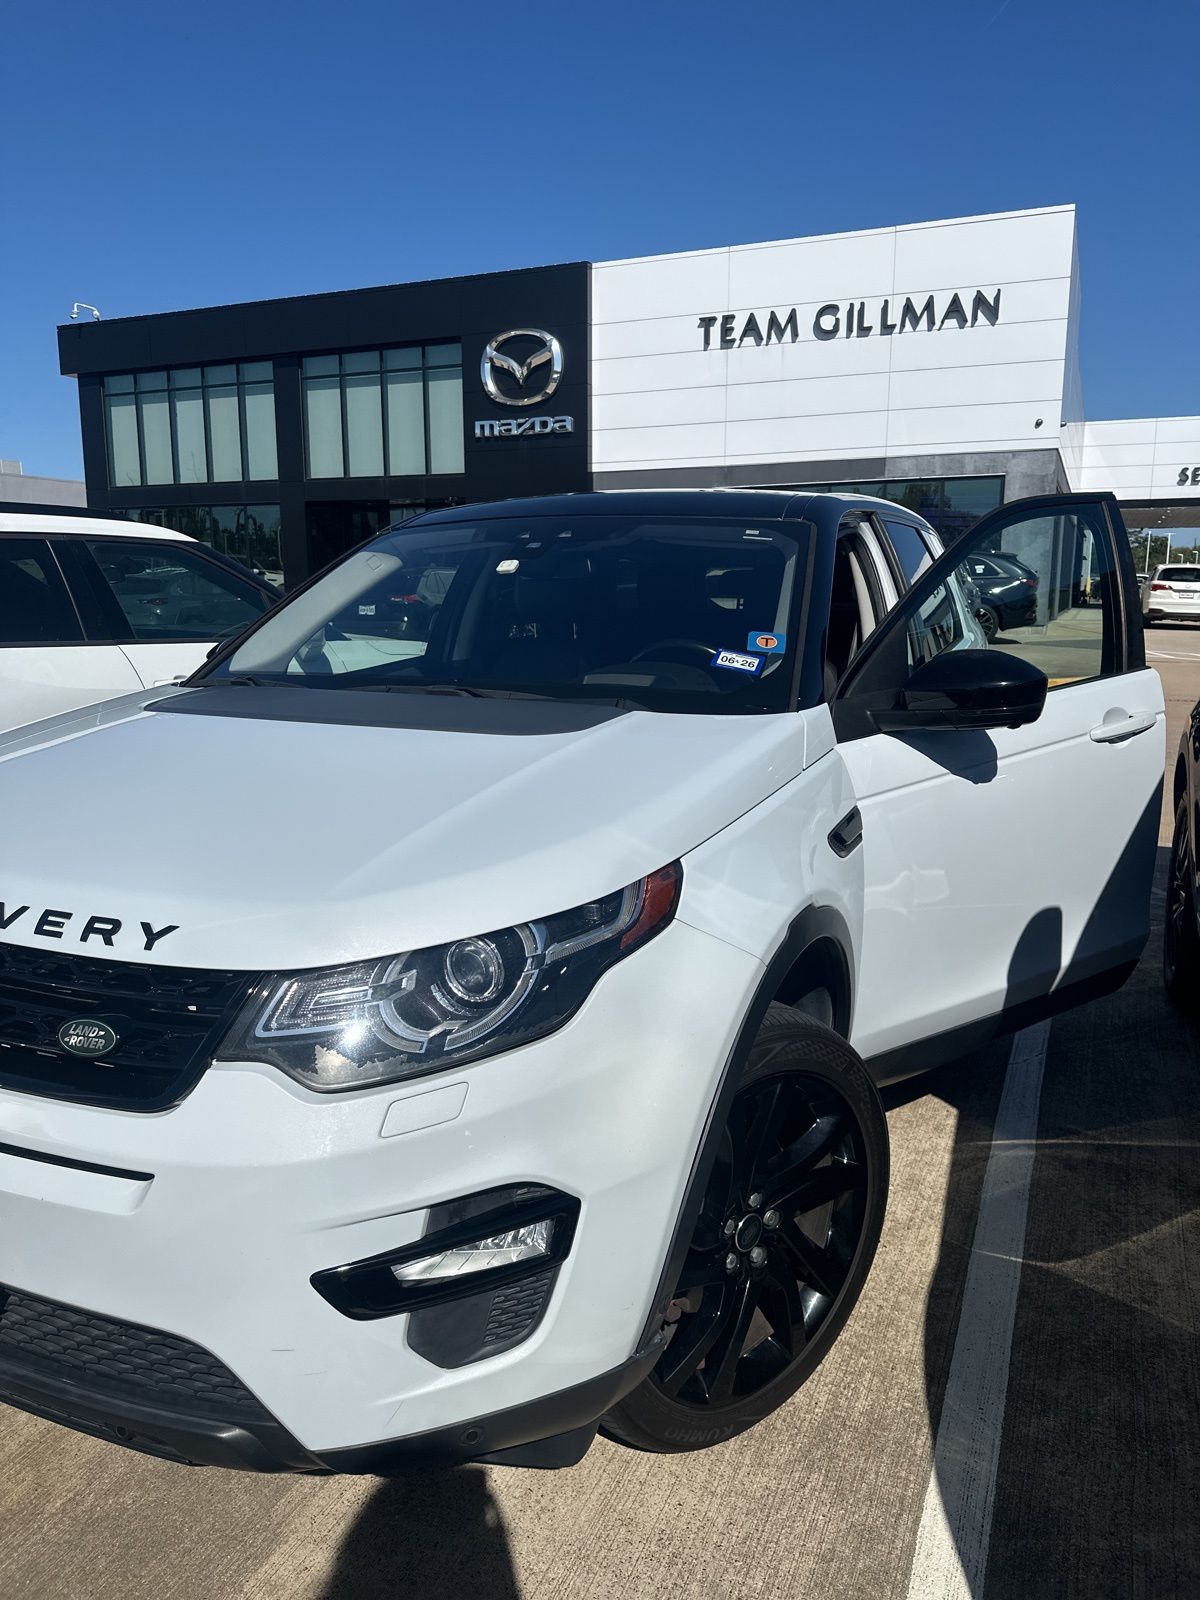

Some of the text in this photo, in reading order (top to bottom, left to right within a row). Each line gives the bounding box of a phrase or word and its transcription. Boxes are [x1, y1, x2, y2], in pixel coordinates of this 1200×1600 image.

[698, 288, 1001, 351] TEAM GILLMAN
[0, 902, 180, 951] VERY
[68, 1023, 99, 1037] LAND
[68, 1035, 106, 1050] ROVER
[664, 1423, 736, 1442] KUMHO
